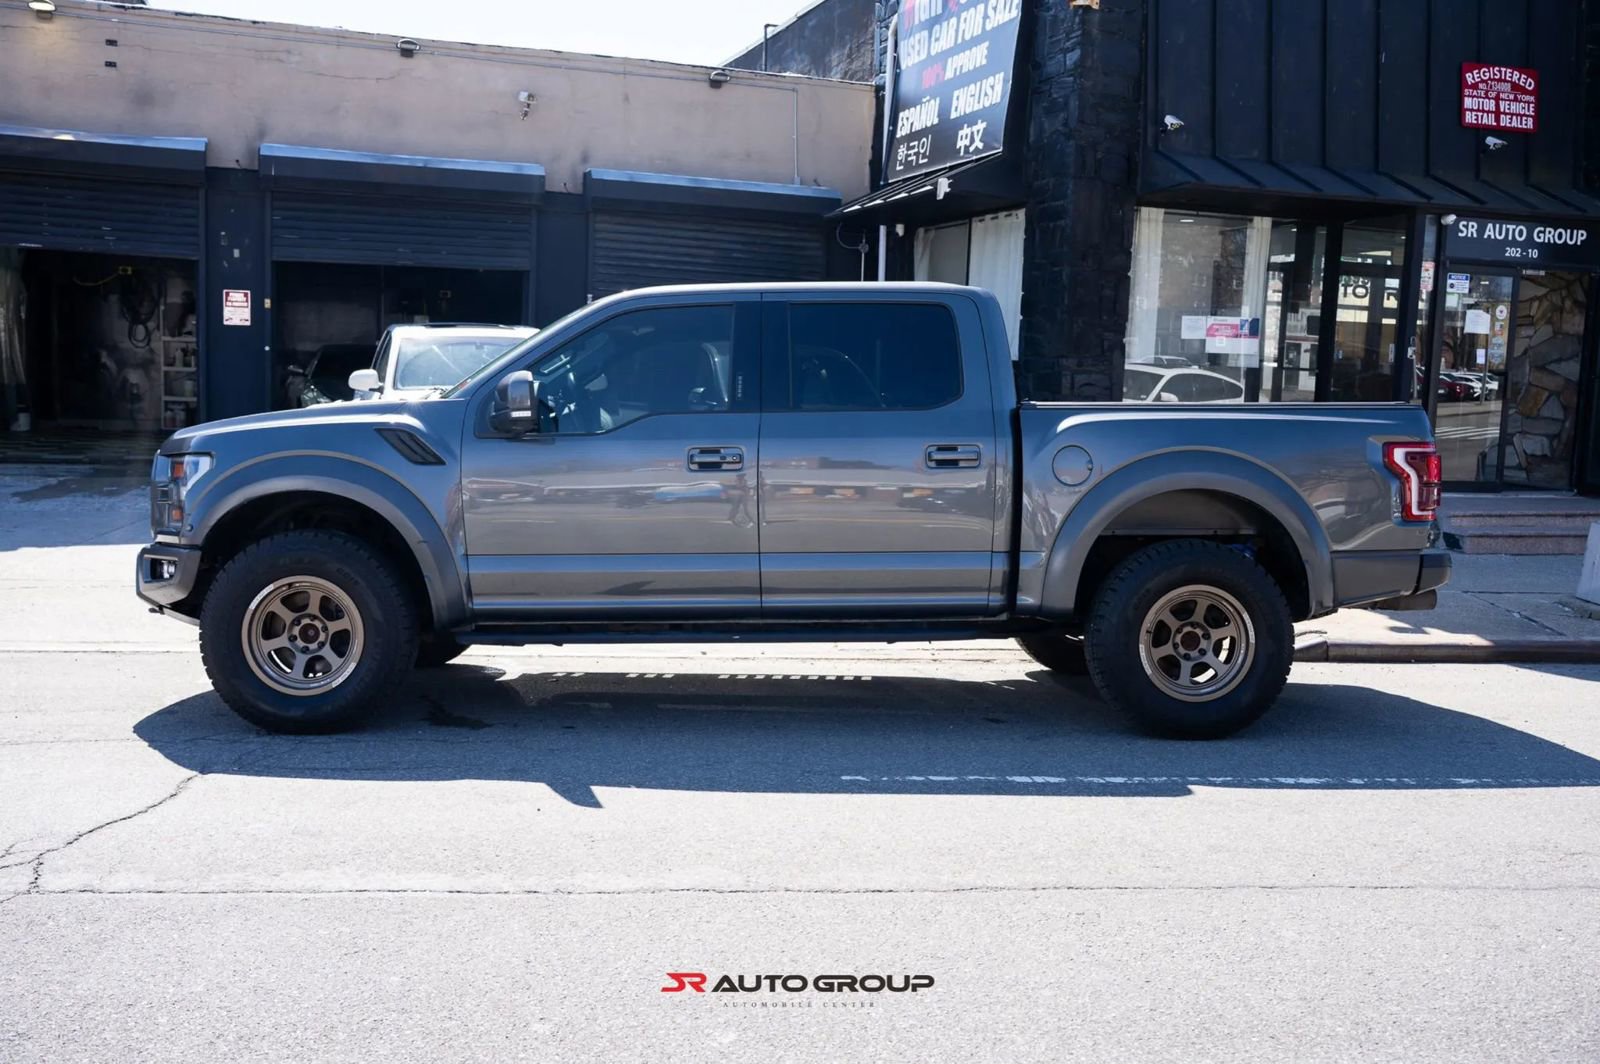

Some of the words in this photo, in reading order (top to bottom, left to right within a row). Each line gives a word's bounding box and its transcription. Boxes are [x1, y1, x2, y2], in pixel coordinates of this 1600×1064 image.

[900, 30, 928, 70] USED
[930, 17, 957, 56] CAR
[957, 3, 985, 44] FOR
[985, 0, 1019, 31] SALE
[944, 41, 989, 80] APPROVE
[1465, 67, 1535, 91] REGISTERED
[896, 95, 940, 138] ESPAÑOL
[950, 72, 1004, 119] ENGLISH
[1464, 89, 1486, 98] STATE
[1517, 94, 1535, 102] YORK
[1464, 97, 1495, 112] MOTOR
[1500, 100, 1535, 115] VEHICLE
[1465, 111, 1497, 126] RETAIL
[1500, 114, 1533, 129] DEALER
[896, 134, 931, 170] 한국인
[956, 119, 987, 156] 中文
[1458, 221, 1478, 238] SR
[1483, 223, 1527, 241] AUTO
[1533, 227, 1587, 246] GROUP
